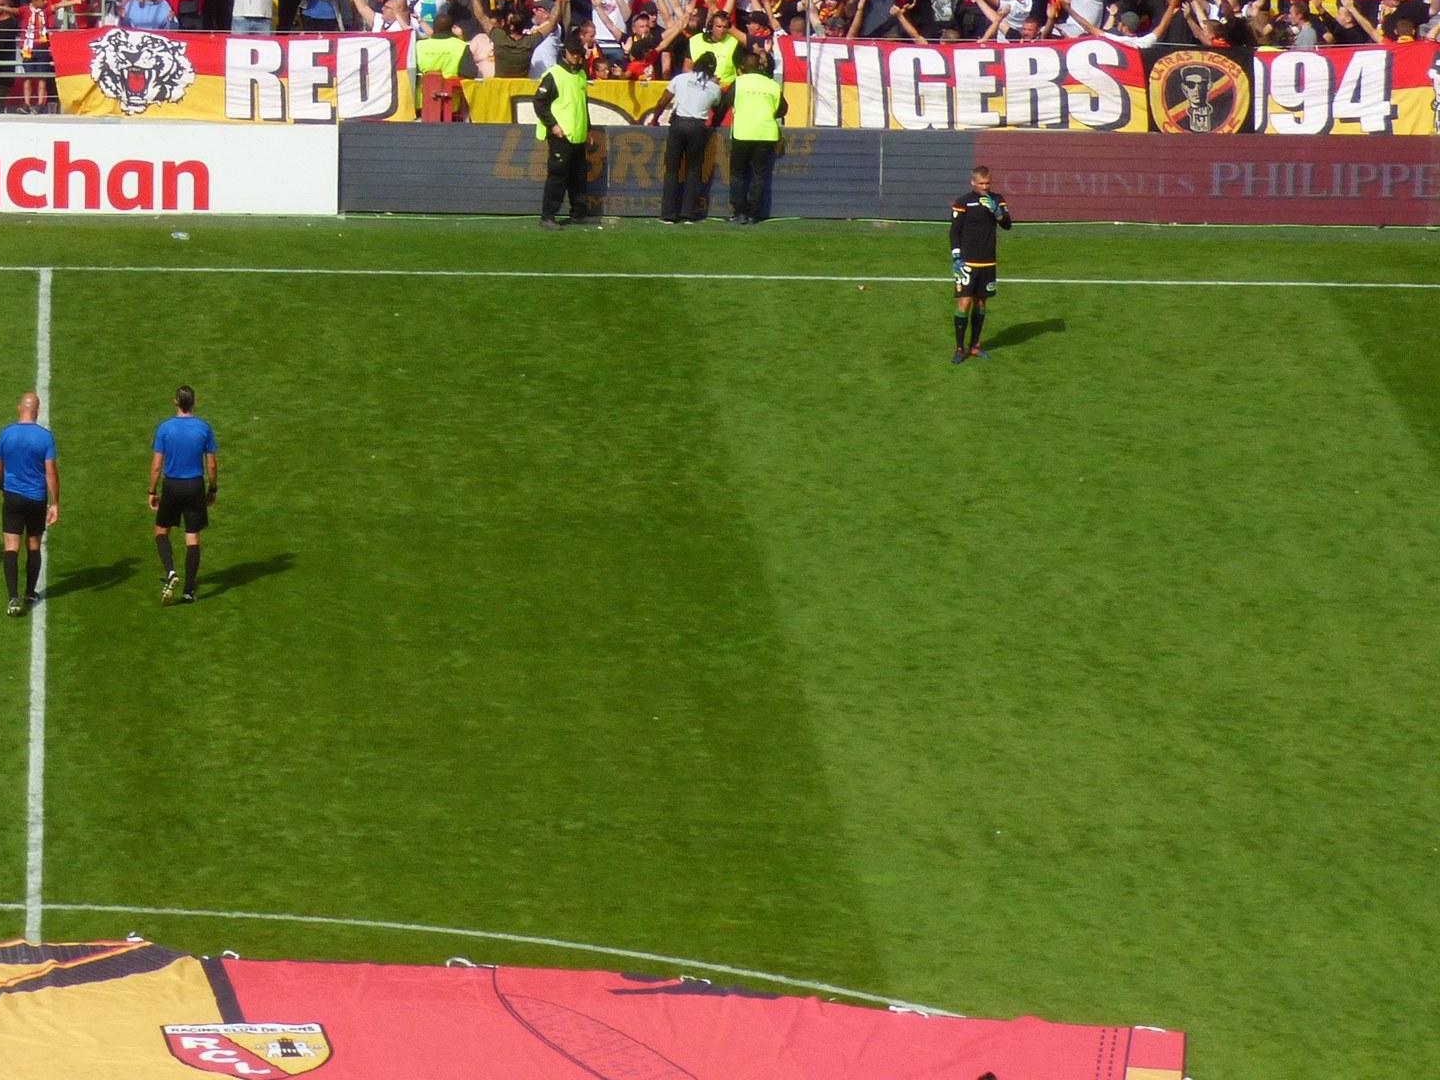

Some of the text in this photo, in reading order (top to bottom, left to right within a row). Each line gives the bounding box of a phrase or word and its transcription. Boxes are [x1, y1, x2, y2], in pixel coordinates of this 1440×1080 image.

[225, 36, 398, 121] RED
[792, 38, 1126, 131] TIGERS
[1209, 161, 1440, 200] PHILIPPE
[180, 1036, 272, 1075] RCL
